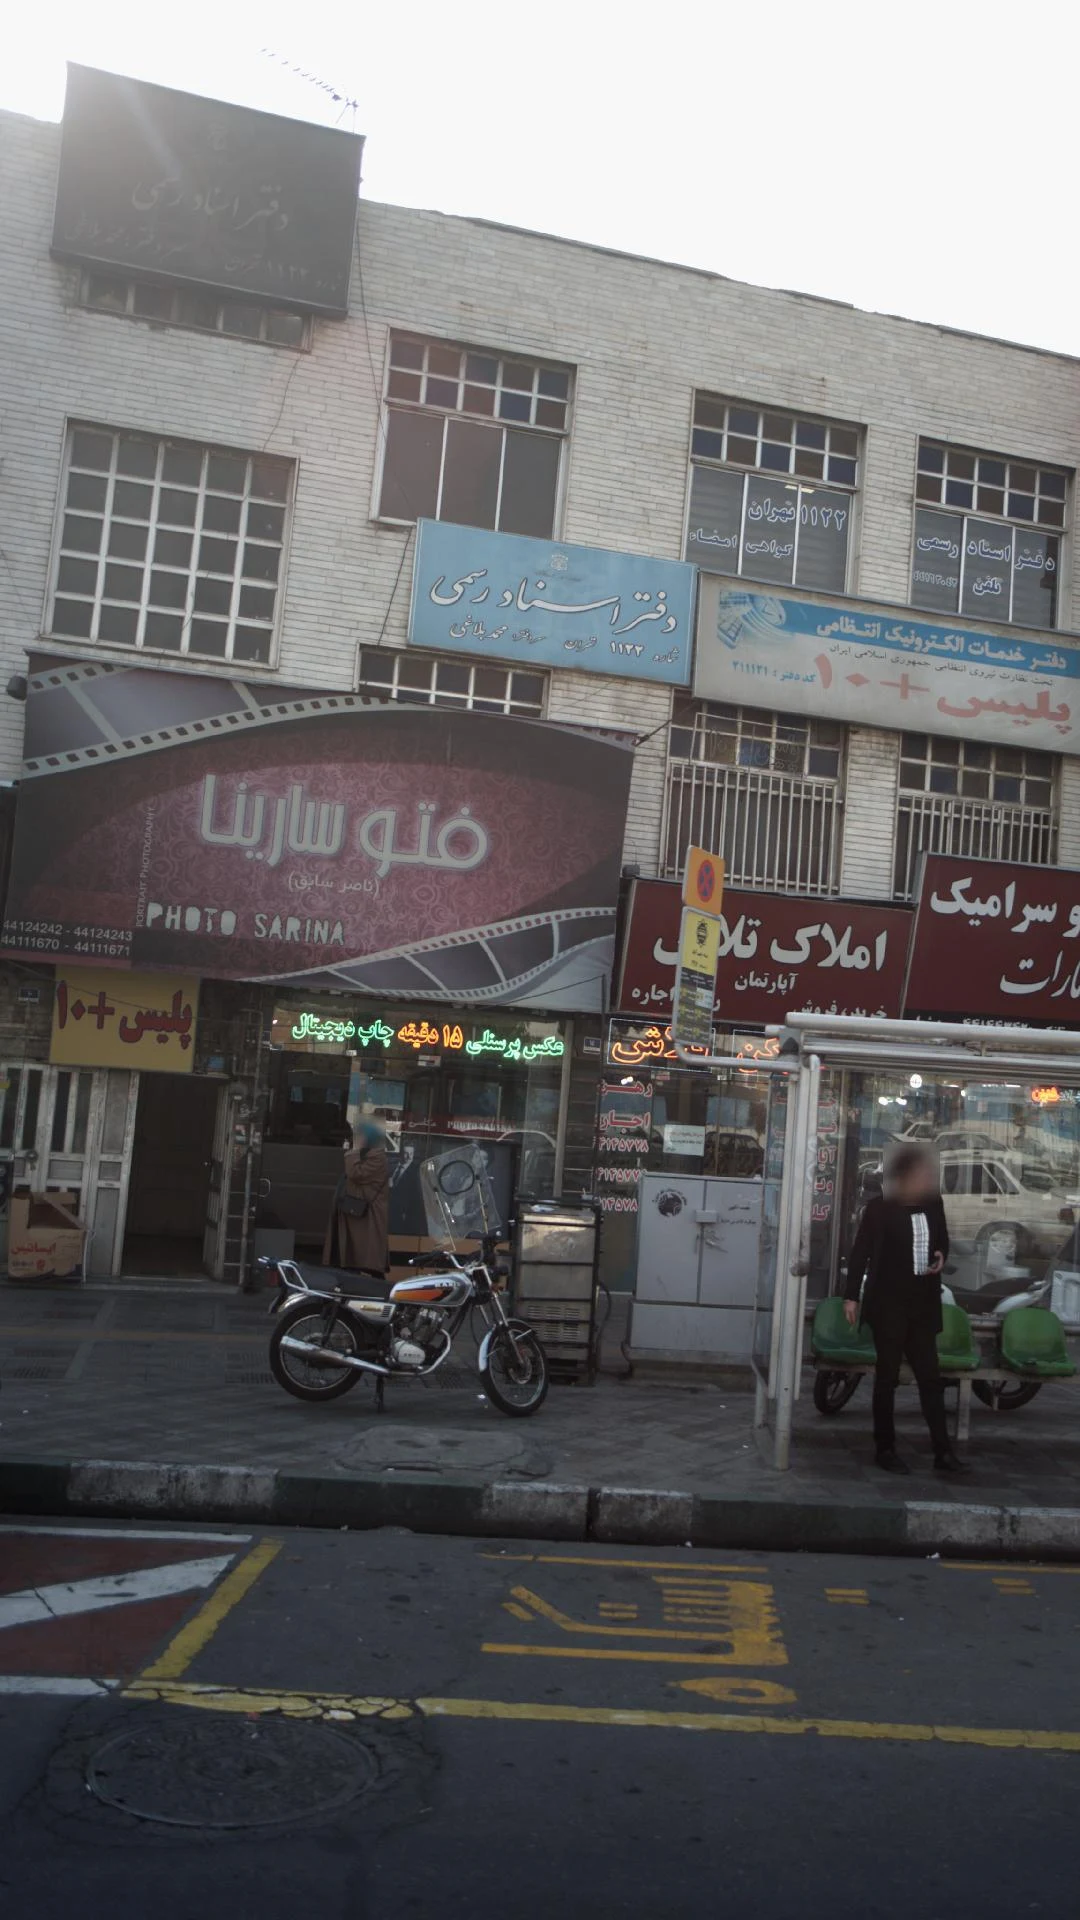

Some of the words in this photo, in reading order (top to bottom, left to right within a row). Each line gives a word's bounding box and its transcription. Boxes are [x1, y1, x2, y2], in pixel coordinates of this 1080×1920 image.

[193, 187, 240, 218] اسناد
[233, 184, 289, 231] دفتر
[748, 498, 796, 523] تهران
[800, 504, 848, 531] ۱۱۲۲
[917, 535, 959, 559] رسمی
[966, 538, 1011, 562] اسناد
[1014, 548, 1056, 571] دفتر
[429, 568, 490, 607] رسمی
[972, 575, 1003, 596] تلفن
[496, 576, 620, 626] اسناد
[612, 590, 678, 635] دفتر
[449, 614, 486, 642] بلاغی
[484, 625, 508, 640] محمد
[817, 616, 882, 640] انتظامی
[884, 624, 964, 654] الکترونیک
[564, 636, 599, 652] تهران
[610, 640, 646, 657] ۱۱۲۲
[829, 641, 851, 656] ایران
[854, 646, 888, 661] اسلامی
[967, 641, 1026, 662] خدمات
[890, 655, 931, 668] جمهوری
[934, 661, 967, 674] انتظامی
[968, 667, 996, 678] نیروی
[1029, 650, 1067, 671] دفتر
[998, 671, 1028, 683] نظارت
[1031, 676, 1055, 687] تحت
[935, 689, 1071, 735] پلیس
[200, 773, 345, 866] سارینا
[359, 800, 488, 878] فتو
[930, 876, 1058, 933] سرامیک
[3, 919, 63, 935] 44124242
[73, 926, 133, 942] 44124243
[146, 902, 237, 936] PHOTO
[254, 913, 345, 946] SARINA
[0, 935, 60, 950] 44111670
[73, 941, 131, 957] 44111671
[769, 922, 888, 972] املاک
[734, 970, 799, 997] آپارتمان
[118, 988, 193, 1050] پلیس
[292, 1012, 356, 1043] دیجیتال
[357, 1019, 395, 1048] چاپ
[397, 1021, 439, 1048] دقیقه
[443, 1023, 464, 1048] ۱۵
[465, 1029, 521, 1060] پرسنلی
[522, 1037, 564, 1060] عکس
